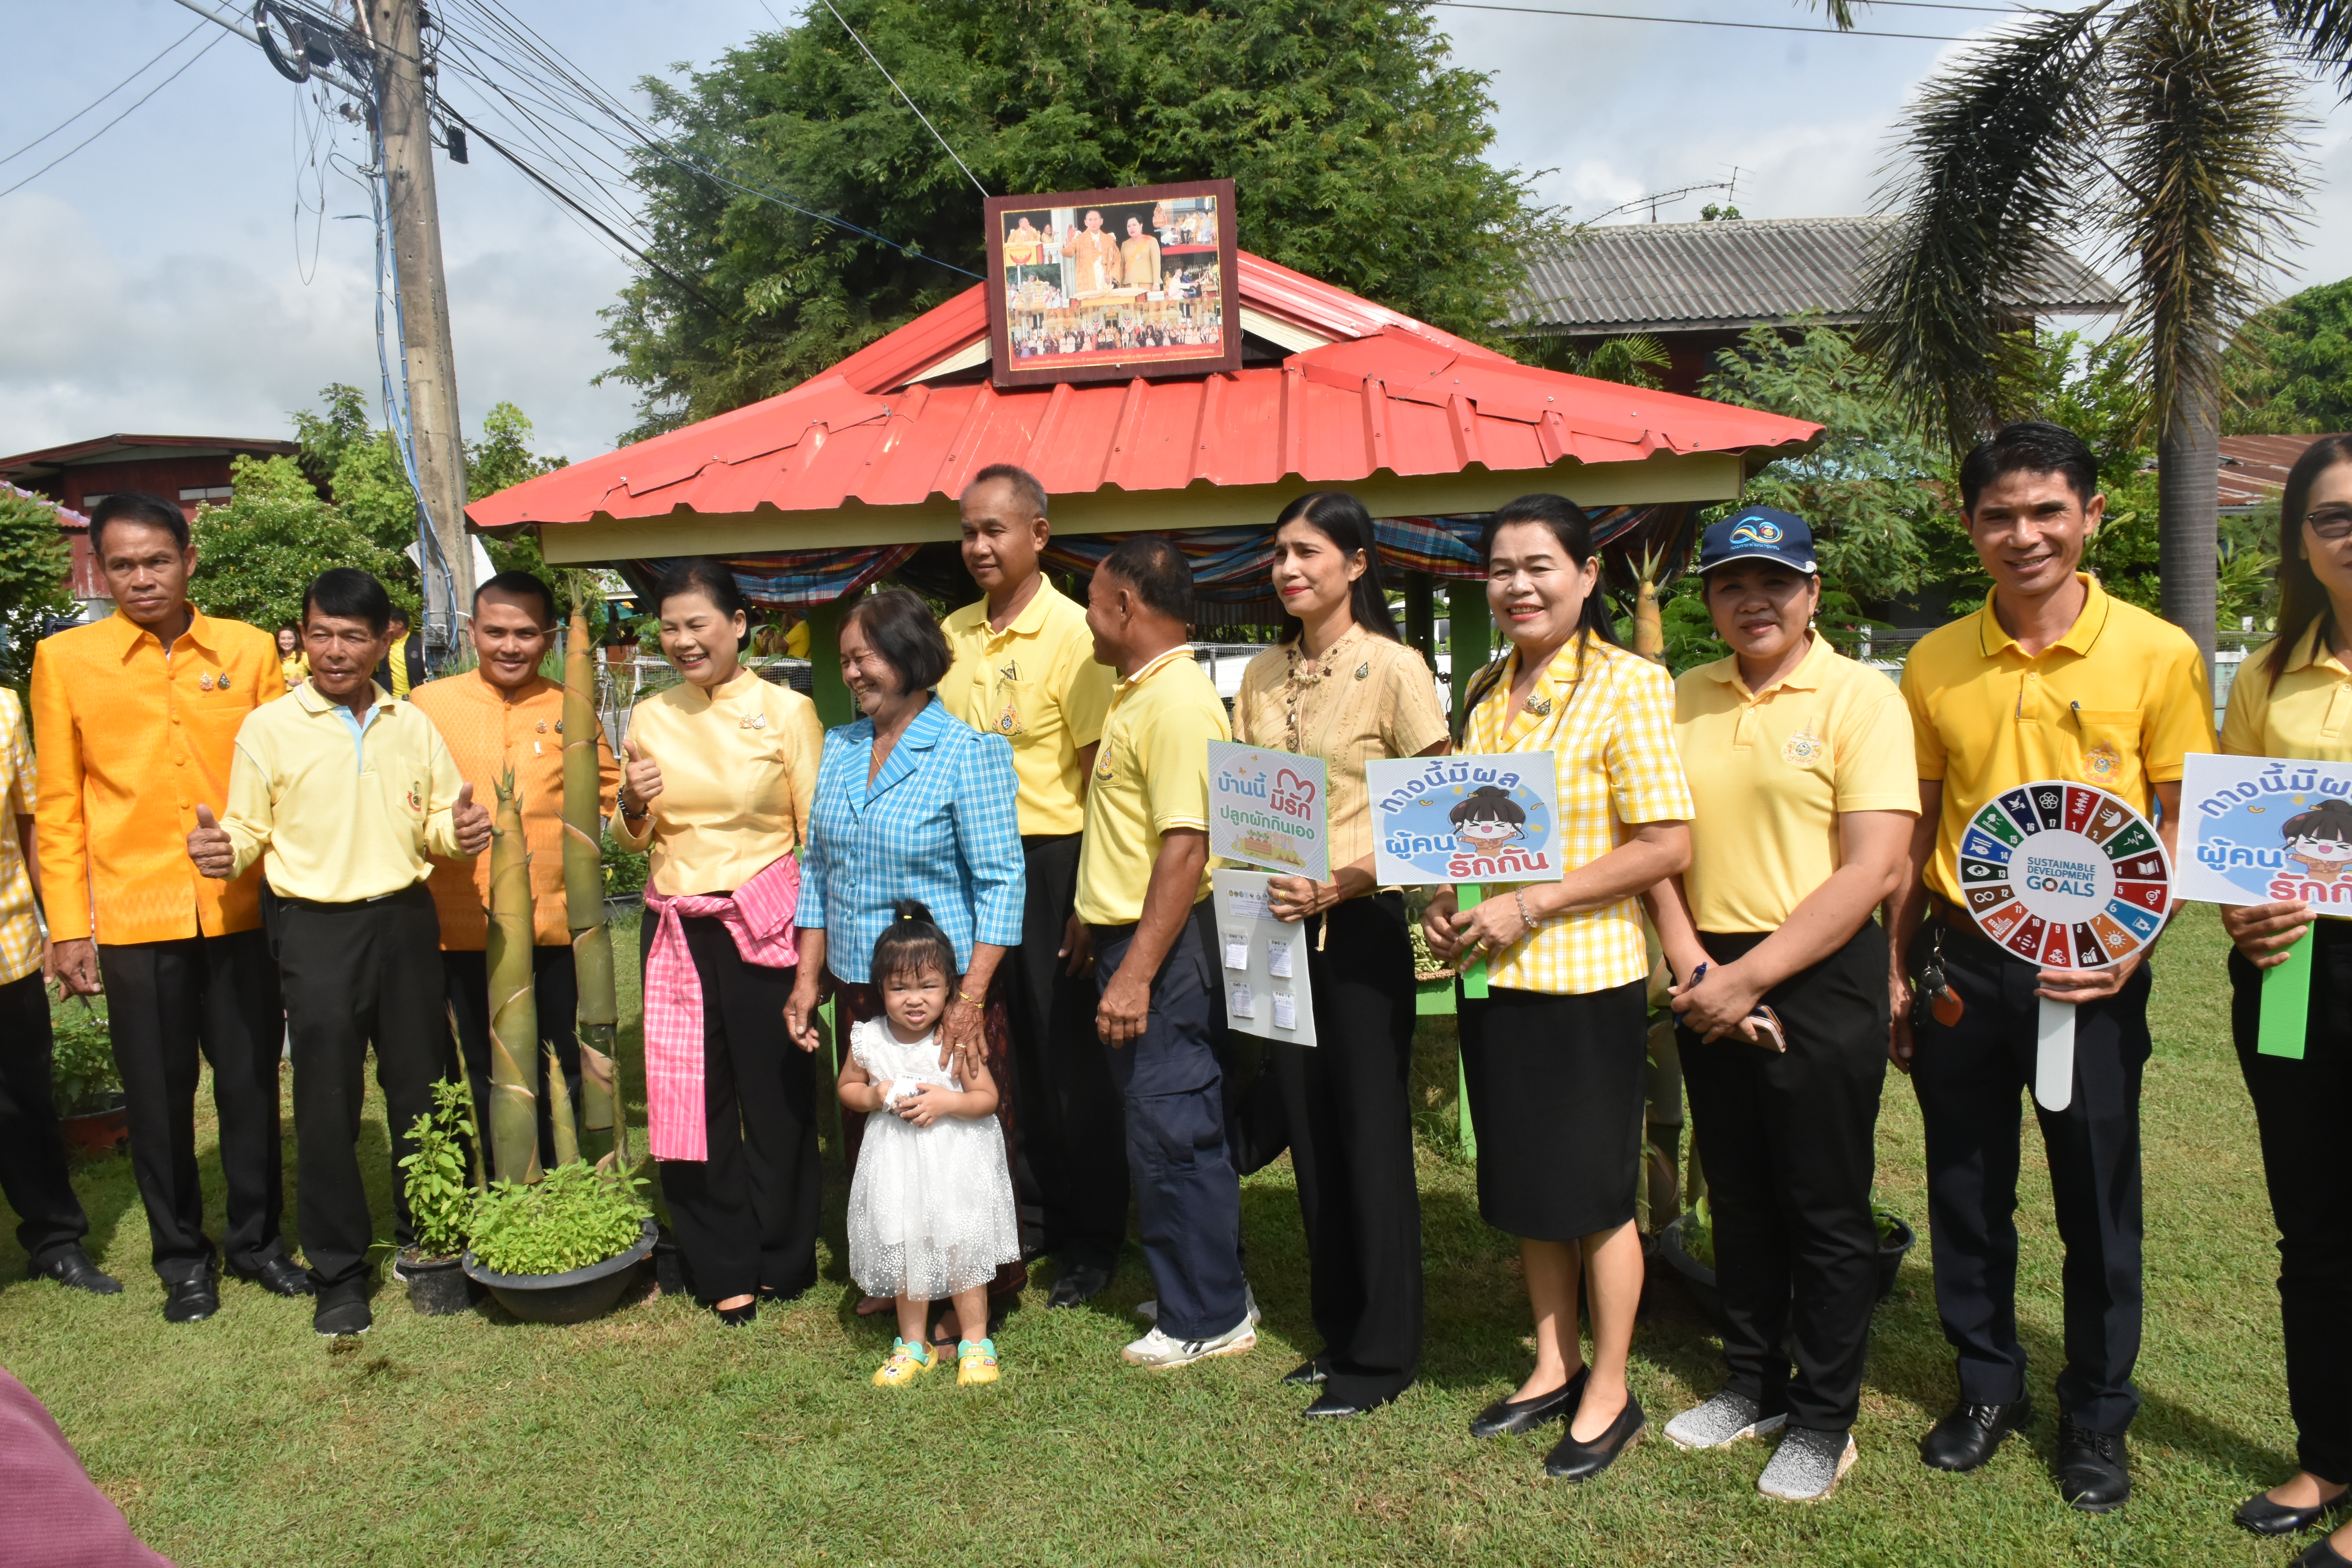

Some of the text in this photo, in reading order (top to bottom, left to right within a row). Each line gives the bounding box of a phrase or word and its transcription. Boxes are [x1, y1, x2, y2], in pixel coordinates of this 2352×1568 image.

[1730, 542, 1780, 550] กรมการพัฒนาชุมชน
[1218, 771, 1267, 798] บ้านนี้
[1379, 760, 1520, 813] ทางนี้มีผล
[2198, 762, 2352, 817] ทางนี้มีผ
[1270, 788, 1311, 821] มีรัก
[1220, 804, 1315, 840] ปลูกผักกินเอง
[2049, 819, 2056, 828] 17
[2072, 822, 2076, 830] 1
[2026, 823, 2034, 831] 16
[2093, 830, 2098, 839] 2
[2009, 835, 2018, 844] 15
[1385, 832, 1457, 860] ผู้คน
[2107, 846, 2113, 855] 3
[2000, 851, 2008, 860] 14
[2197, 838, 2284, 871] ผู้คน
[1448, 849, 1549, 878] รักกัน
[2027, 857, 2096, 873] SUSTAINABLE
[1998, 869, 2006, 878] 13
[2027, 865, 2095, 882] DEVELOPMENT
[2117, 866, 2122, 875] 4
[2026, 875, 2095, 898] GOALS
[2118, 886, 2123, 894] 5
[2269, 872, 2352, 903] รักก
[2001, 889, 2009, 897] 12
[2015, 905, 2022, 914] 11
[2109, 903, 2117, 913] 6
[2032, 918, 2040, 927] 10
[2096, 916, 2101, 925] 7
[2055, 925, 2060, 933] 9
[2077, 924, 2082, 933] 8
